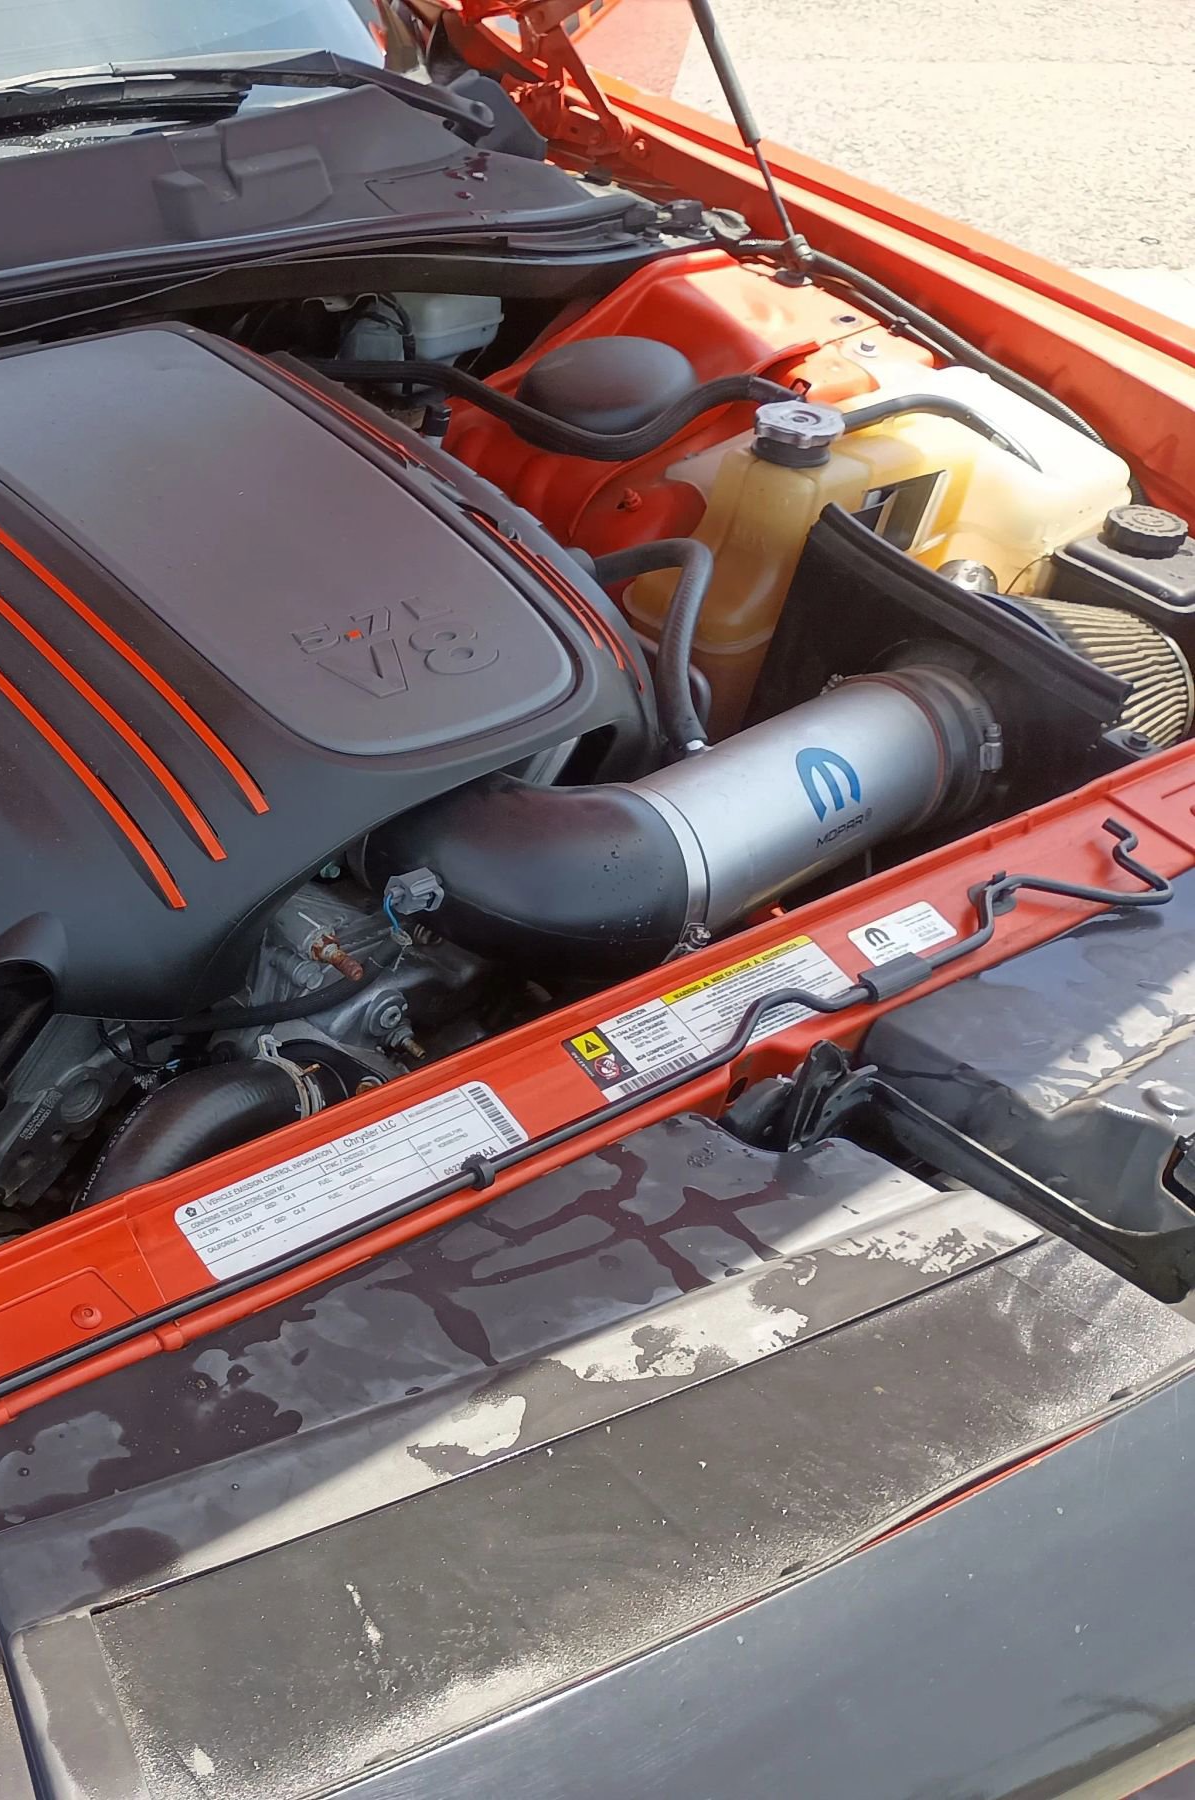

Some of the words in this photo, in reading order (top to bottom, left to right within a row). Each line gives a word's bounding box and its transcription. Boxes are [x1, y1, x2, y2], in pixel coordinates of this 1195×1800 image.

[291, 596, 452, 654] 5.7L
[315, 623, 499, 698] V8
[816, 814, 865, 848] MOPAR
[616, 1008, 647, 1024] ATTENTION
[623, 1028, 645, 1041] FACTORY
[342, 1128, 379, 1148] Chrysler
[377, 1119, 397, 1133] LLC
[444, 1146, 498, 1175] 0527AA
[206, 1190, 234, 1206] VEHICLE
[233, 1178, 264, 1195] EMISSION
[262, 1167, 293, 1182] CONTROL
[291, 1149, 333, 1170] INFORMATION
